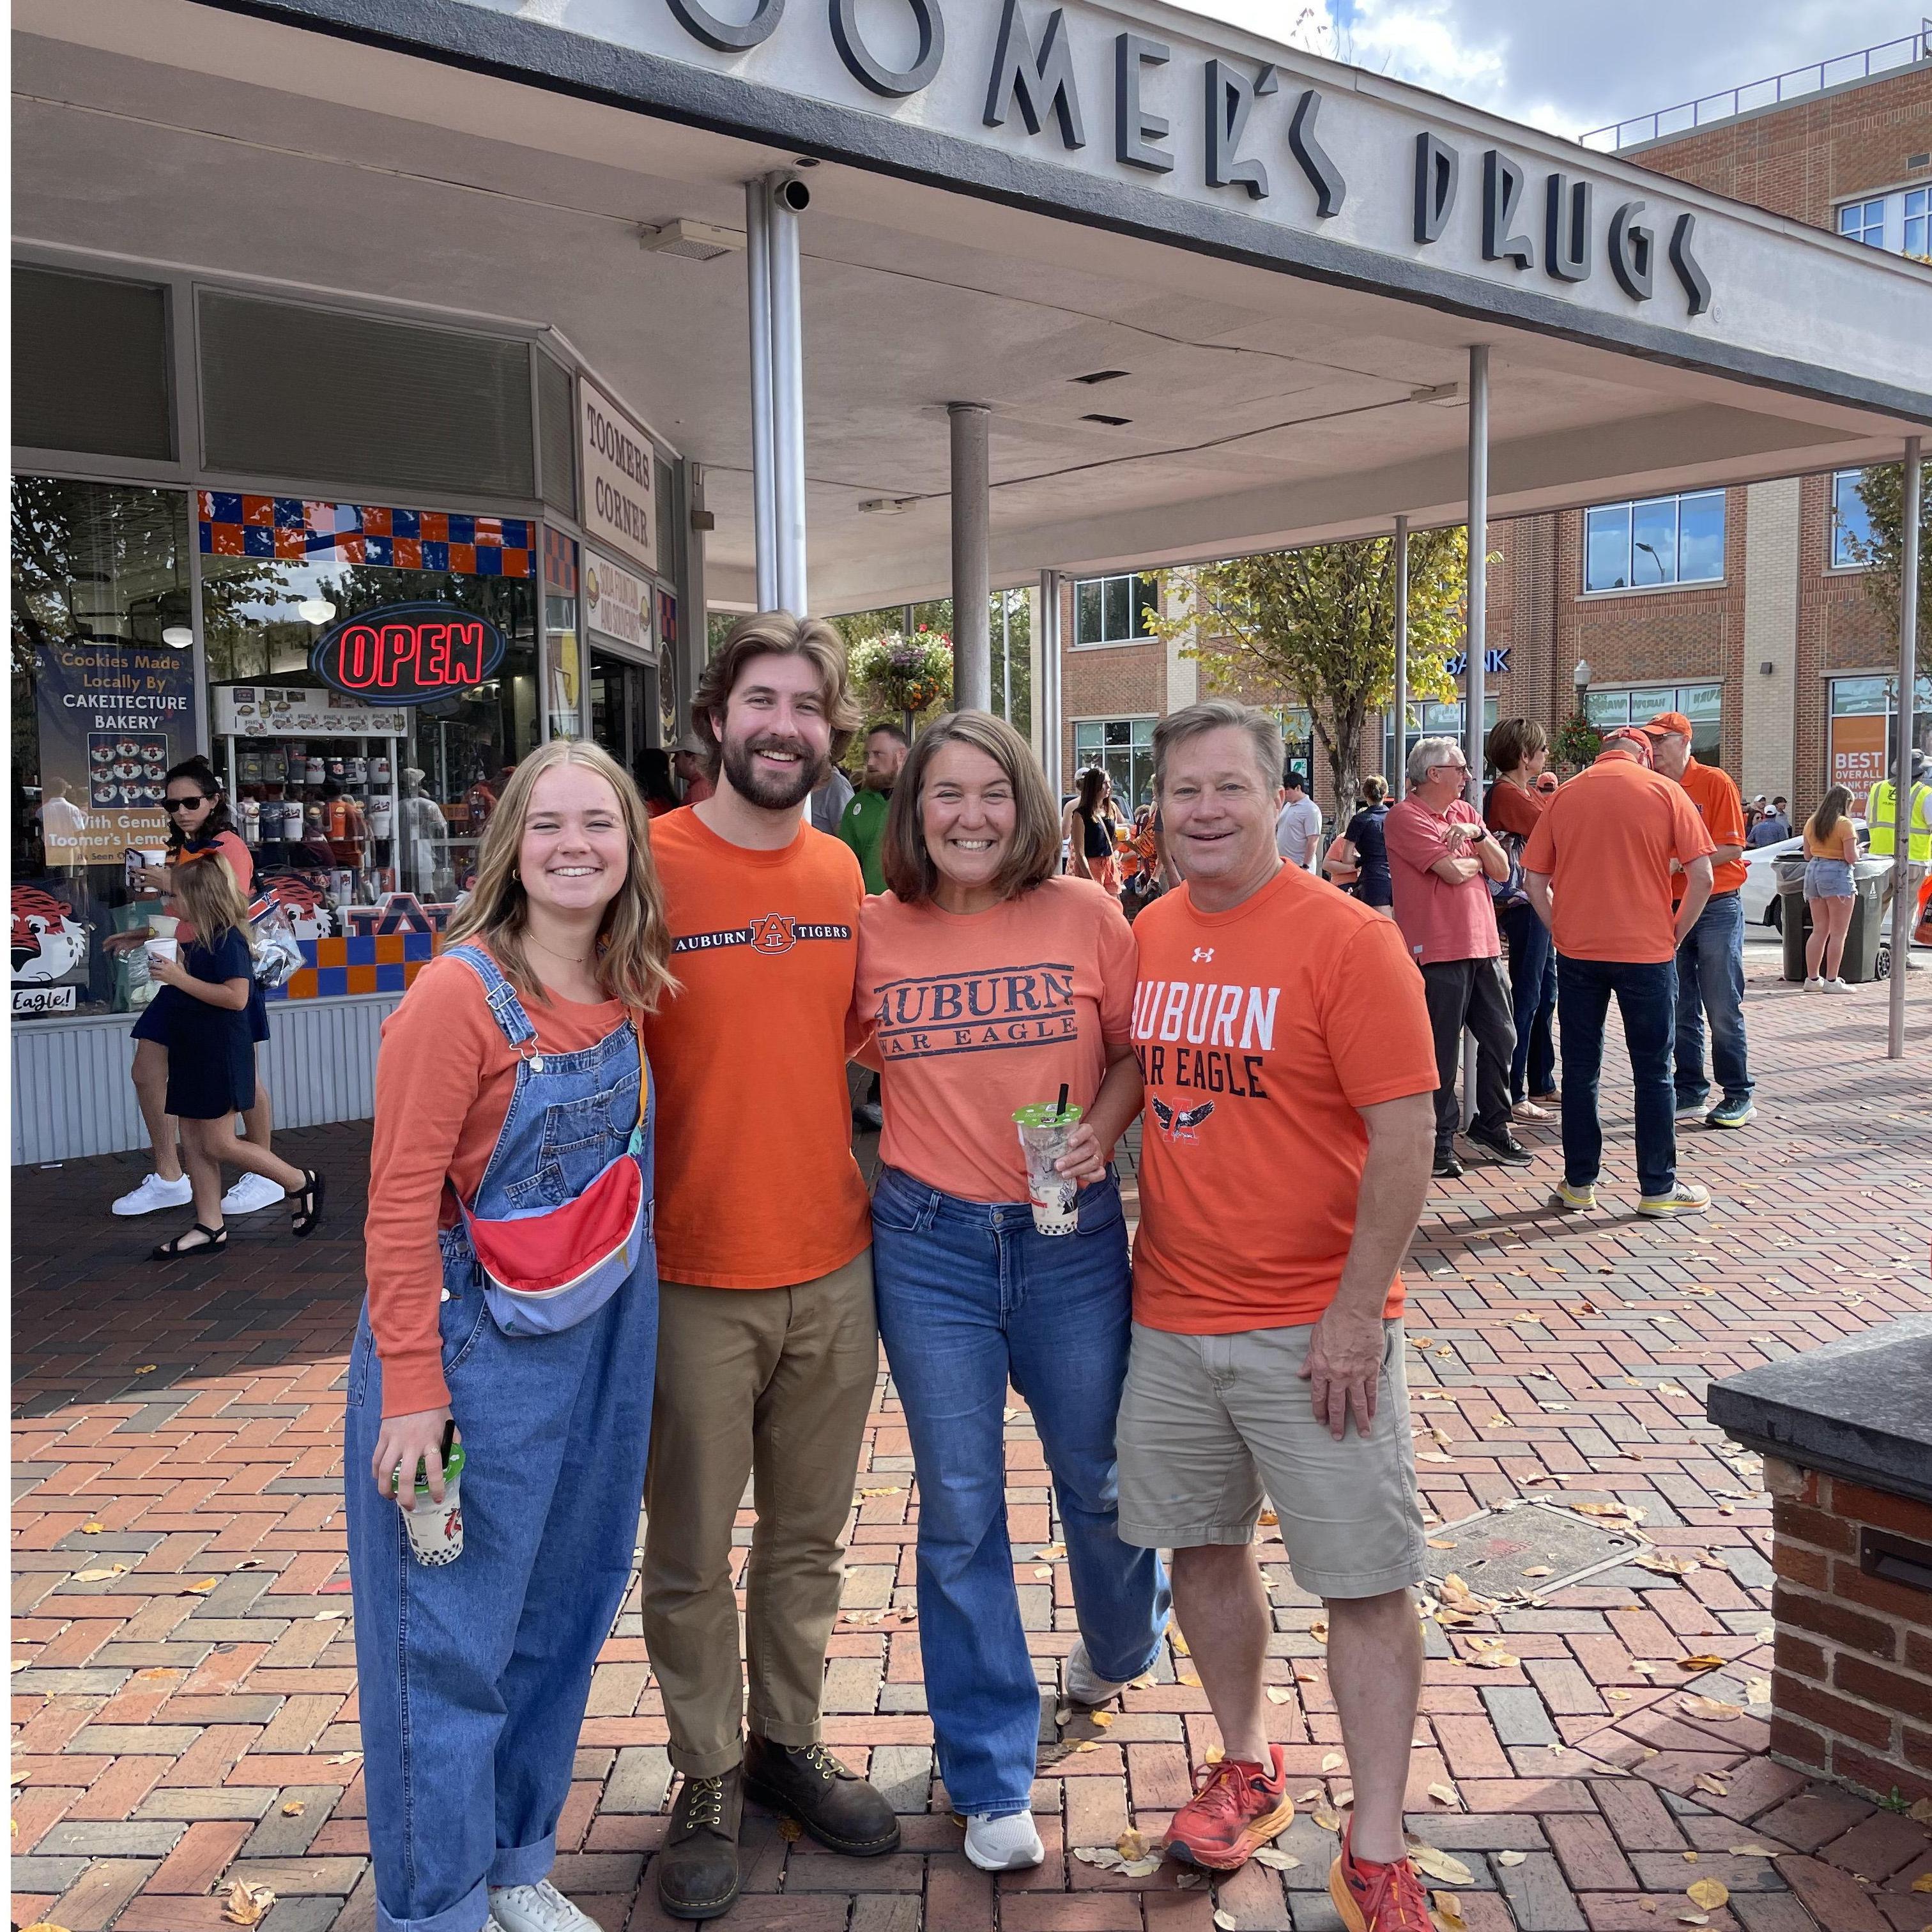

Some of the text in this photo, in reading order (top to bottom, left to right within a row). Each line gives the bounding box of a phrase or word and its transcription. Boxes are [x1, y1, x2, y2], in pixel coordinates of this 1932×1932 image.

[1413, 132, 1712, 316] DRUGS
[587, 402, 650, 492] TOOMERS
[595, 476, 648, 549] CORNER
[62, 652, 180, 670] Cookies Made
[339, 622, 484, 688] OPEN
[83, 674, 166, 693] Locally By
[63, 694, 187, 710] CAKEITECTURE
[95, 715, 158, 729] BAKERY
[1835, 752, 1883, 769] BEST
[1836, 770, 1882, 779] OVERALL
[72, 815, 170, 830] With Genui
[49, 832, 121, 847] Toomer's
[91, 852, 114, 861] Seen
[675, 931, 746, 951] AUBURN
[799, 925, 848, 939] TIGERS
[13, 989, 71, 1011] Eagle!
[874, 972, 1074, 1027] AUBURN
[953, 1017, 1077, 1045] EAGLE
[1176, 1047, 1270, 1100] EAGLE
